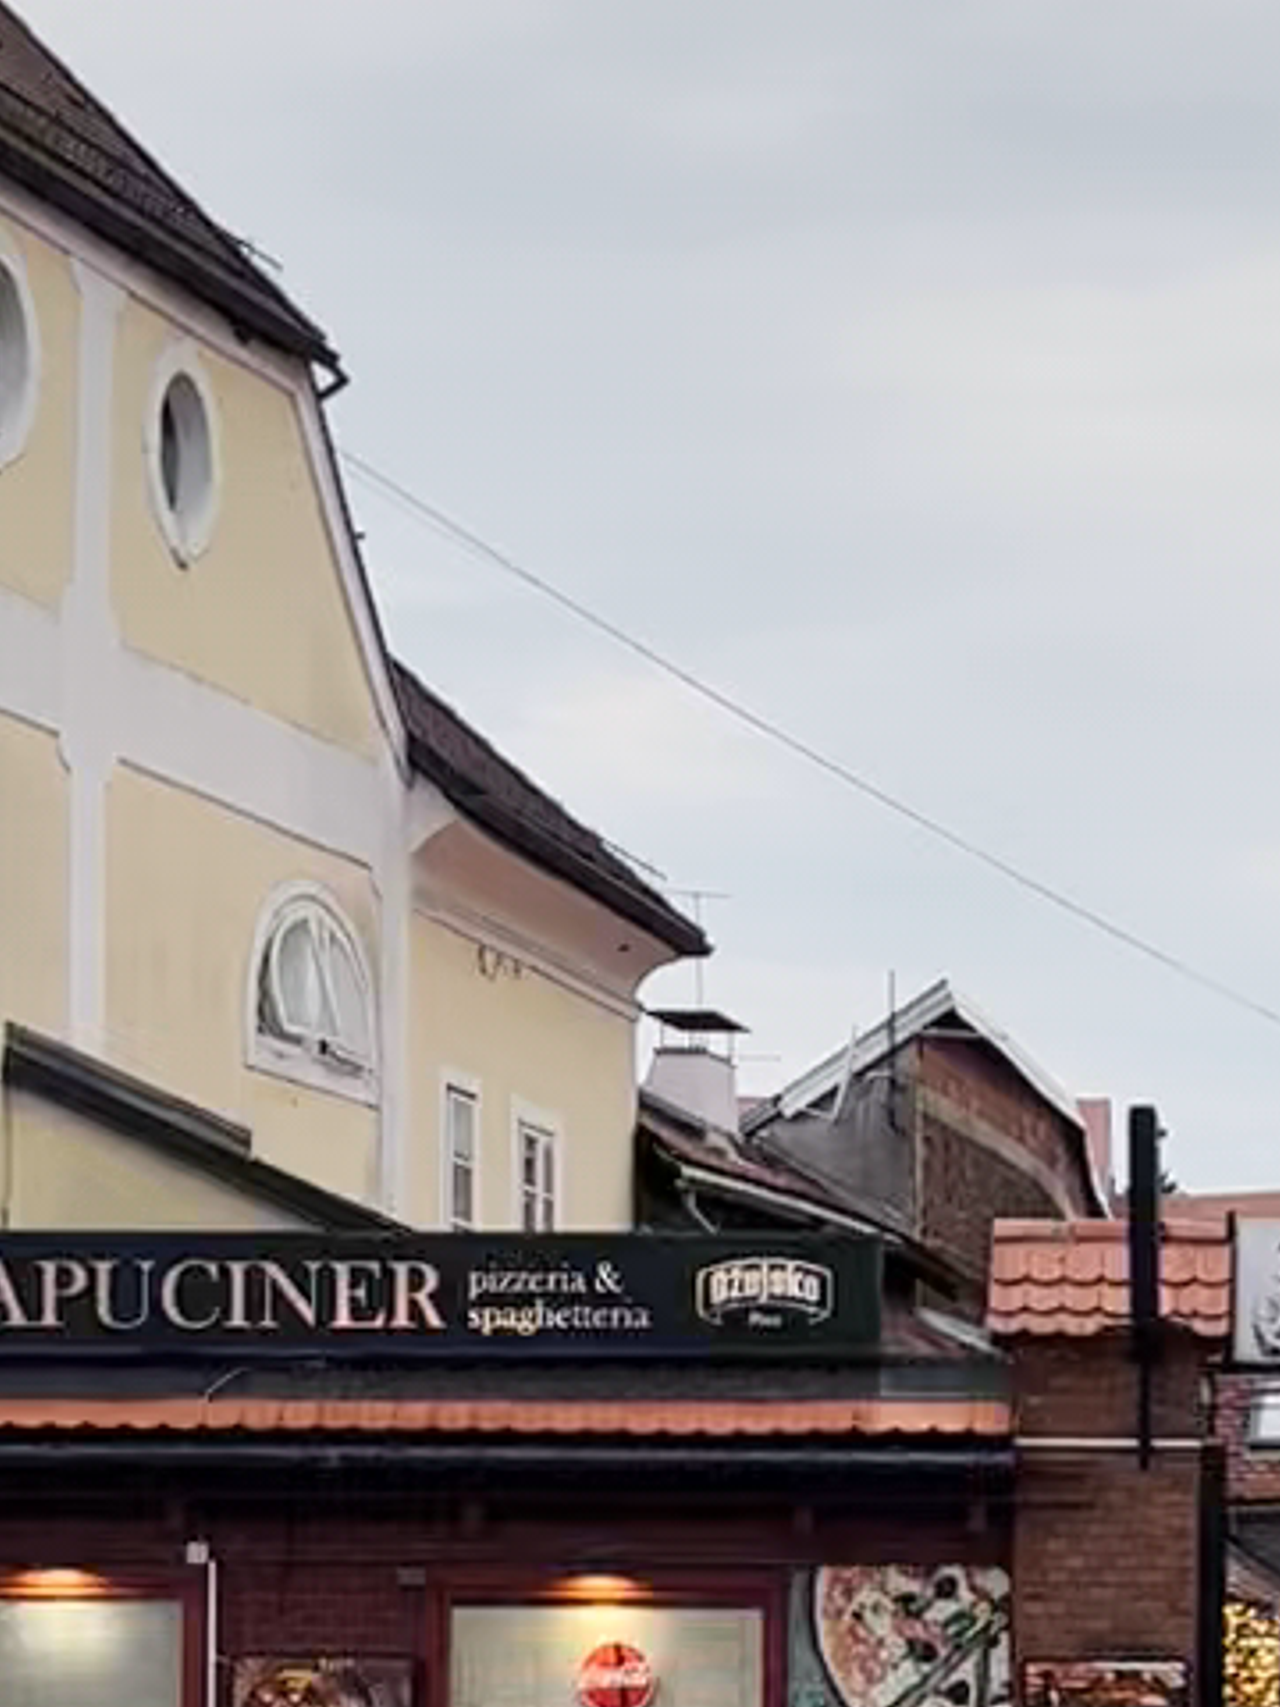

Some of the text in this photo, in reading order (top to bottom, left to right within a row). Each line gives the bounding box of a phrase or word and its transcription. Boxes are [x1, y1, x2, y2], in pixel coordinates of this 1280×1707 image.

[468, 1260, 623, 1300] pizzeria &
[467, 1297, 651, 1337] spaghetteria
